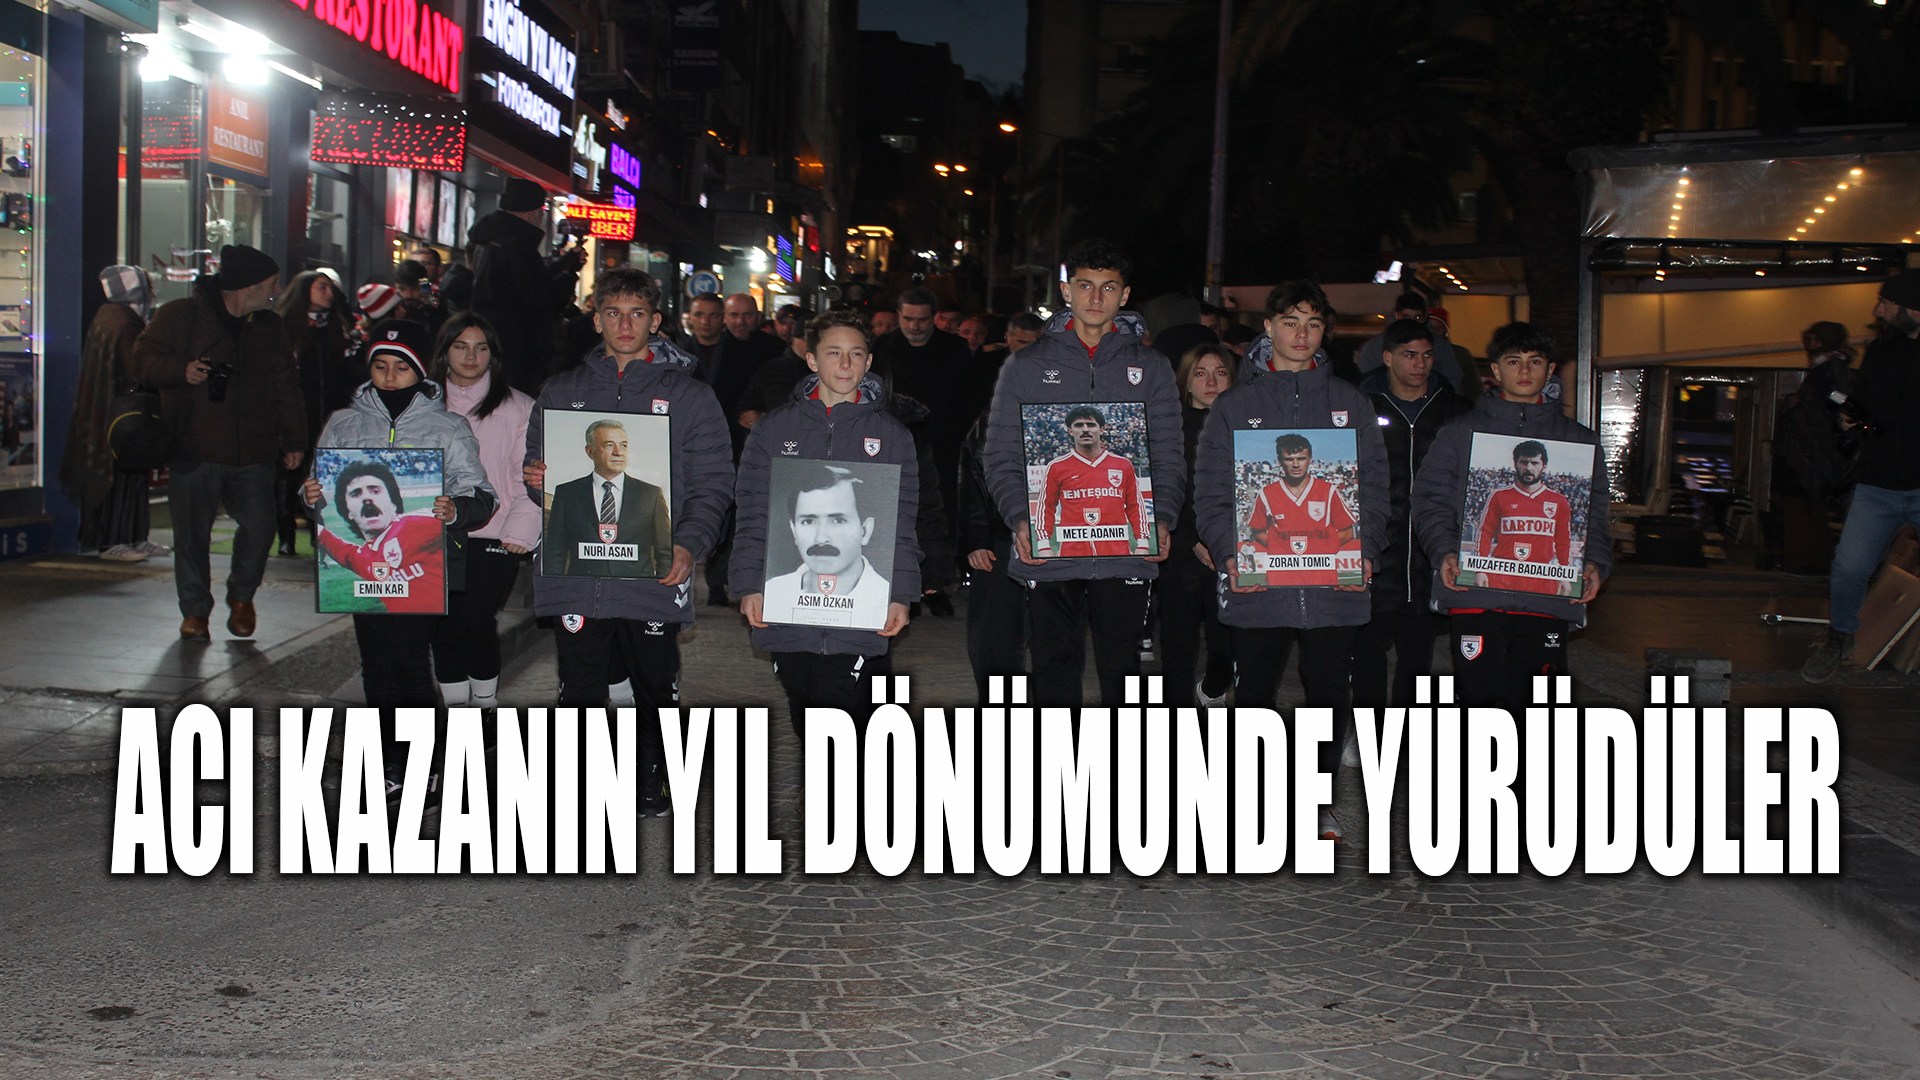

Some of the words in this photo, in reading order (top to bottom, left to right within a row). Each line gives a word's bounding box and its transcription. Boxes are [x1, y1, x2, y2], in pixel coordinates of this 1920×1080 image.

[483, 0, 530, 66] ENGİN
[529, 20, 577, 100] YILMAZ
[212, 125, 265, 160] RESTAURANT
[1062, 528, 1088, 540] METE
[1090, 527, 1125, 540] ADANIR
[583, 544, 606, 558] NURİ
[608, 546, 634, 558] ASAN
[1269, 557, 1300, 569] ZORAN
[1301, 556, 1331, 568] TOMIC
[1466, 558, 1516, 573] MUZAFFER
[1517, 562, 1575, 580] BADALIOĞLU
[359, 582, 383, 595] EMİN
[384, 583, 404, 595] KAR
[797, 594, 821, 607] ASIM
[823, 594, 855, 609] ÖZKAN
